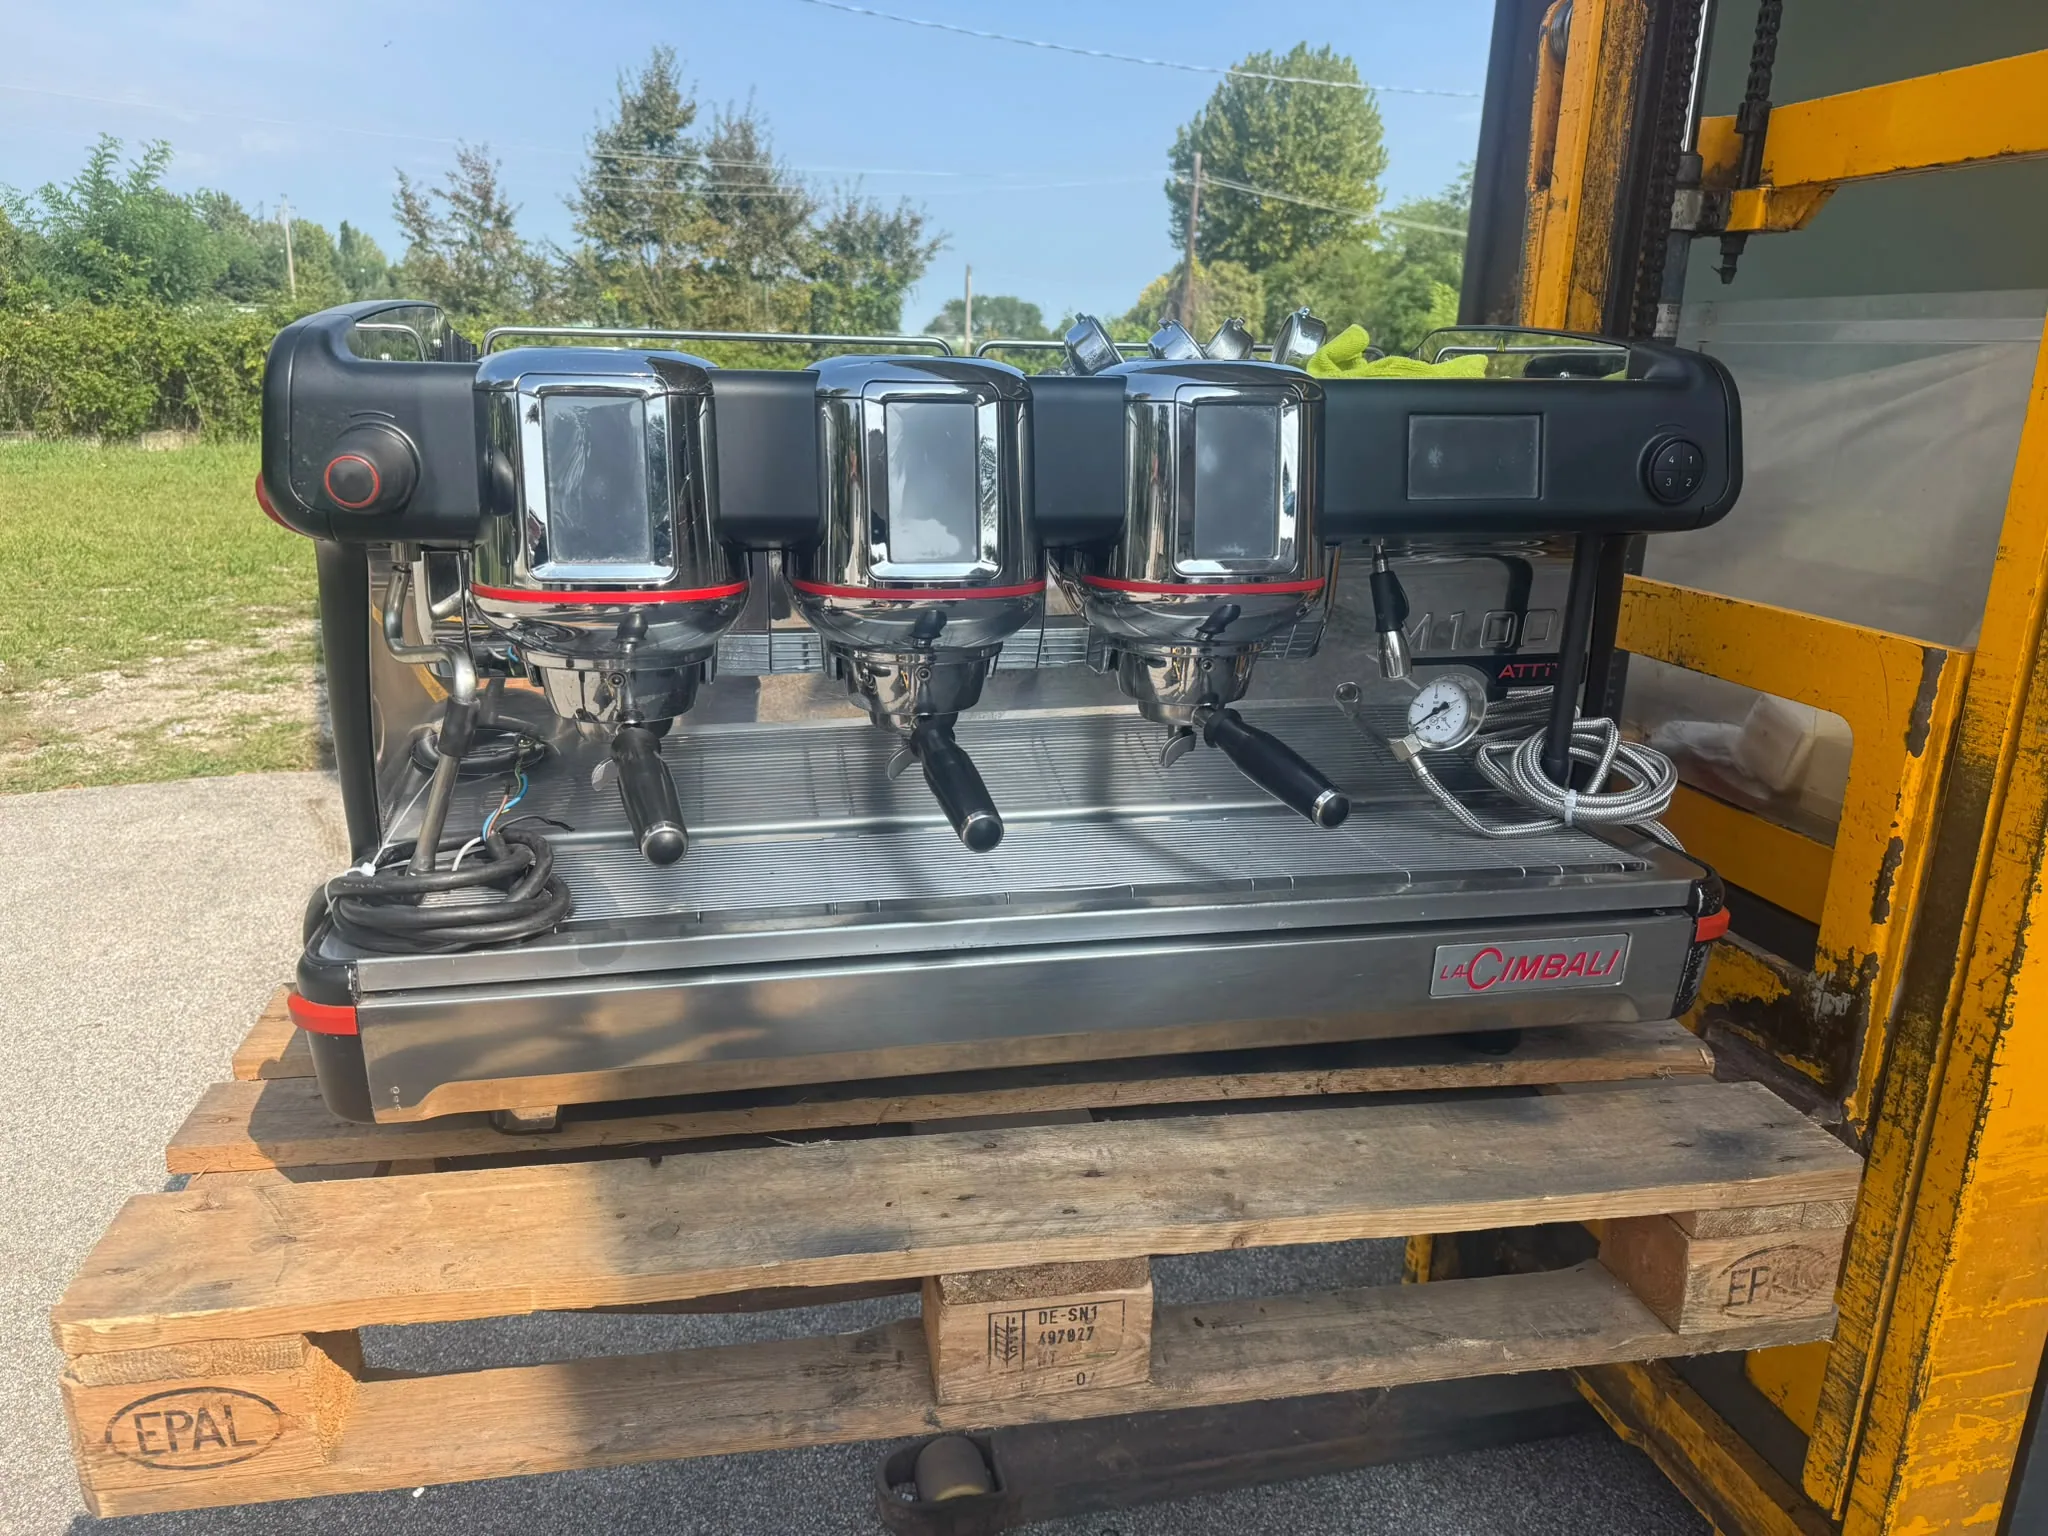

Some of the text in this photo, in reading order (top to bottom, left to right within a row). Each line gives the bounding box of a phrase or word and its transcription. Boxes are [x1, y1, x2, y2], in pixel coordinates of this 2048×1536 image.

[1668, 455, 1675, 464] 4
[1688, 455, 1693, 464] 1
[1665, 477, 1672, 487] 3
[1685, 478, 1692, 487] 2
[1440, 947, 1621, 990] LA CIMBALI
[1038, 1305, 1098, 1325] DE-SN1
[134, 1404, 257, 1455] EPAL
